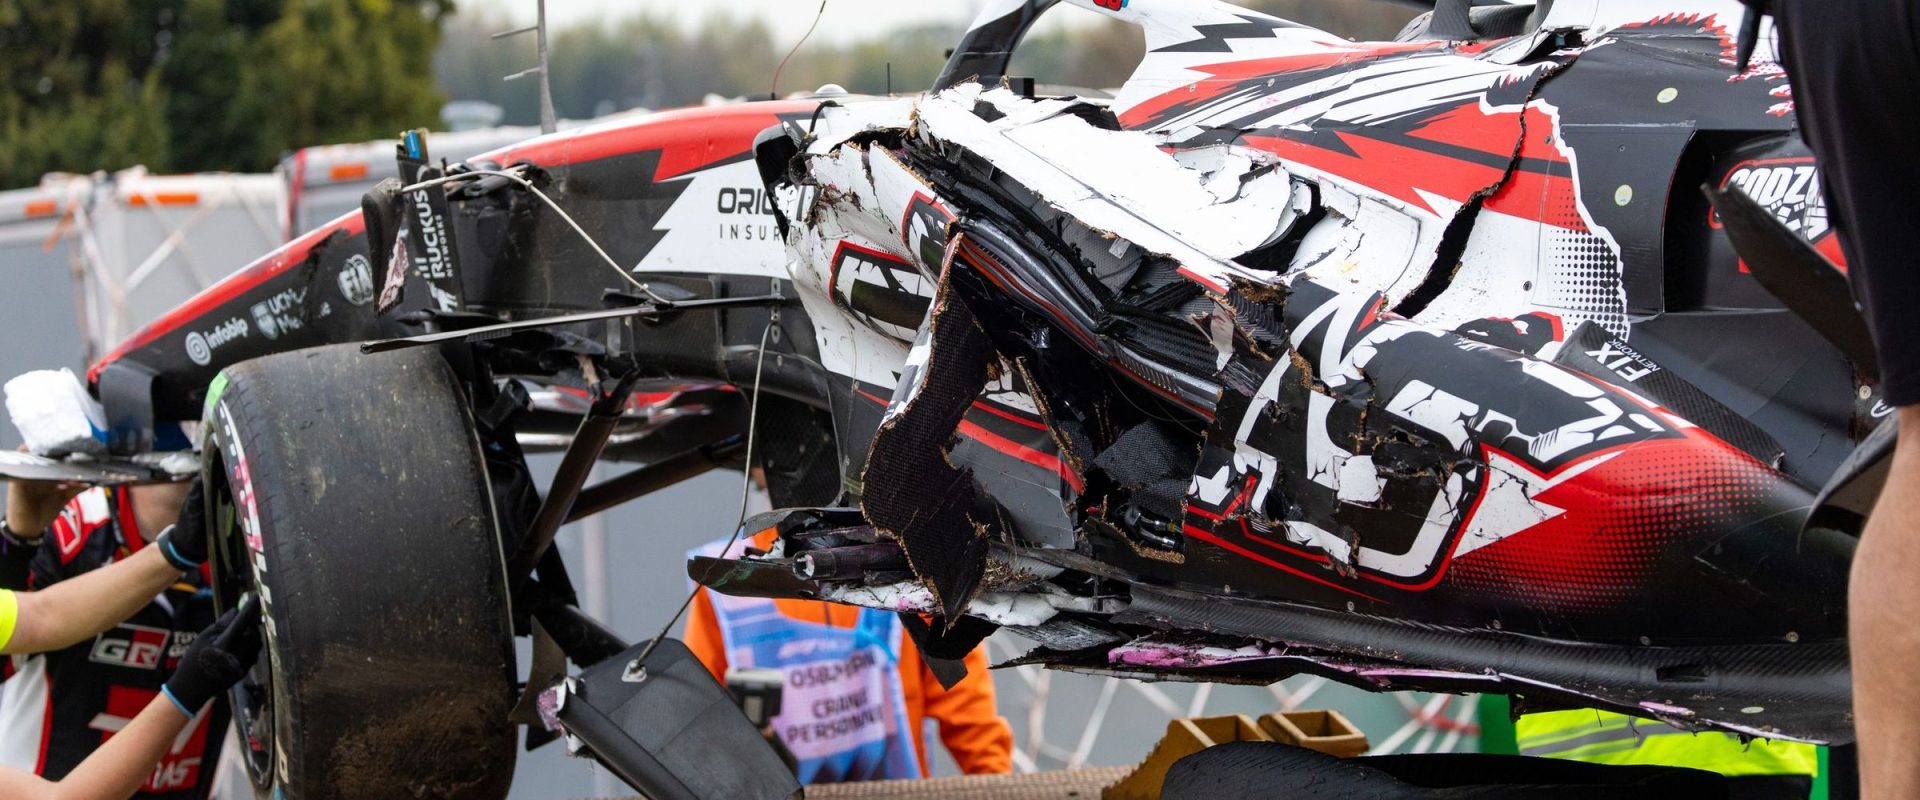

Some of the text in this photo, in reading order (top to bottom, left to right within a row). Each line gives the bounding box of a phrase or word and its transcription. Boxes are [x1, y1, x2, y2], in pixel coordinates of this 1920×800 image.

[413, 189, 446, 278] RUCKUS
[434, 214, 454, 277] NETWORKS
[204, 317, 248, 349] infobip
[1584, 342, 1652, 382] FIX
[1607, 339, 1661, 372] NETWORK
[97, 638, 161, 667] GR
